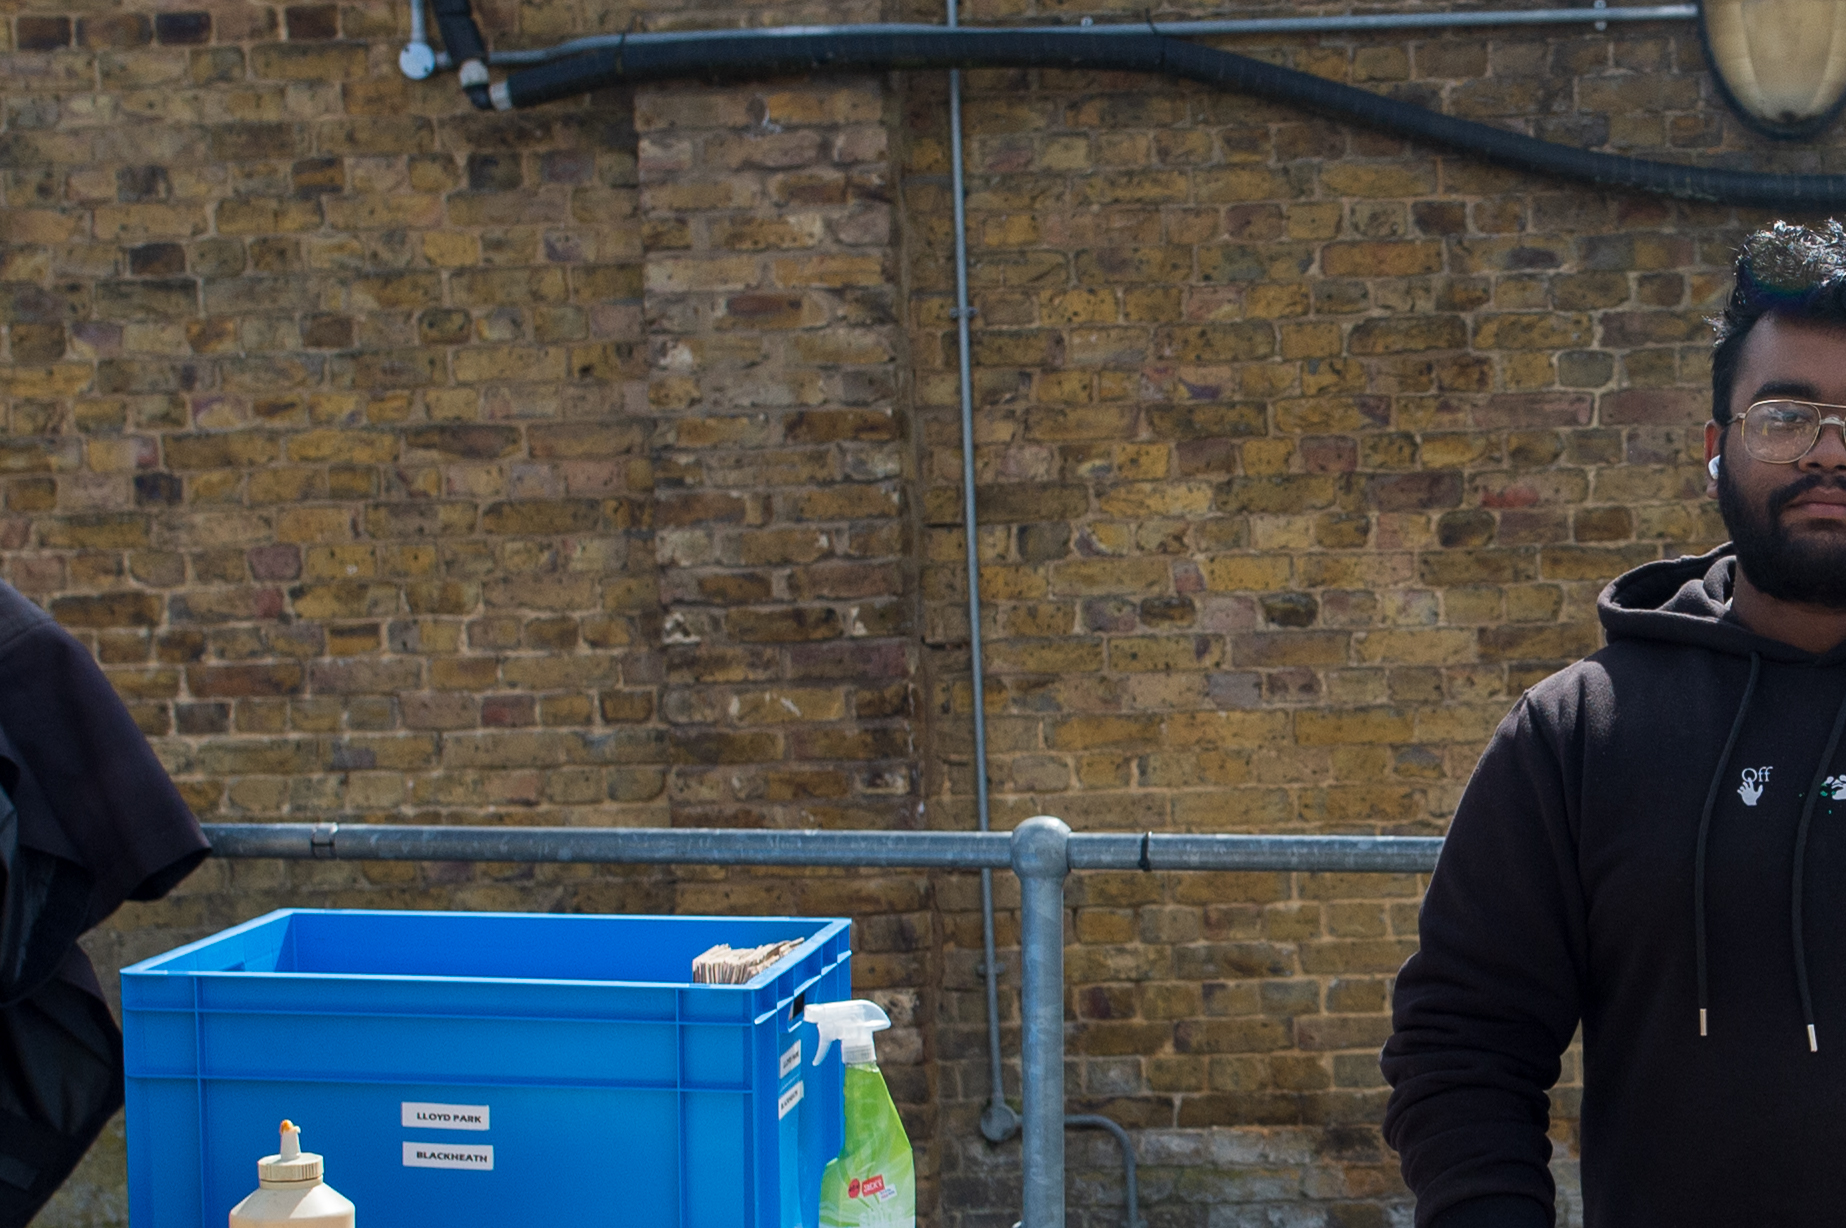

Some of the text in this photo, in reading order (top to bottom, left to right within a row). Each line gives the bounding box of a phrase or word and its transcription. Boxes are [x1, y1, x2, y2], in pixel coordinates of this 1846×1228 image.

[1741, 766, 1773, 783] Off
[416, 1112, 482, 1124] LLOYD PARK
